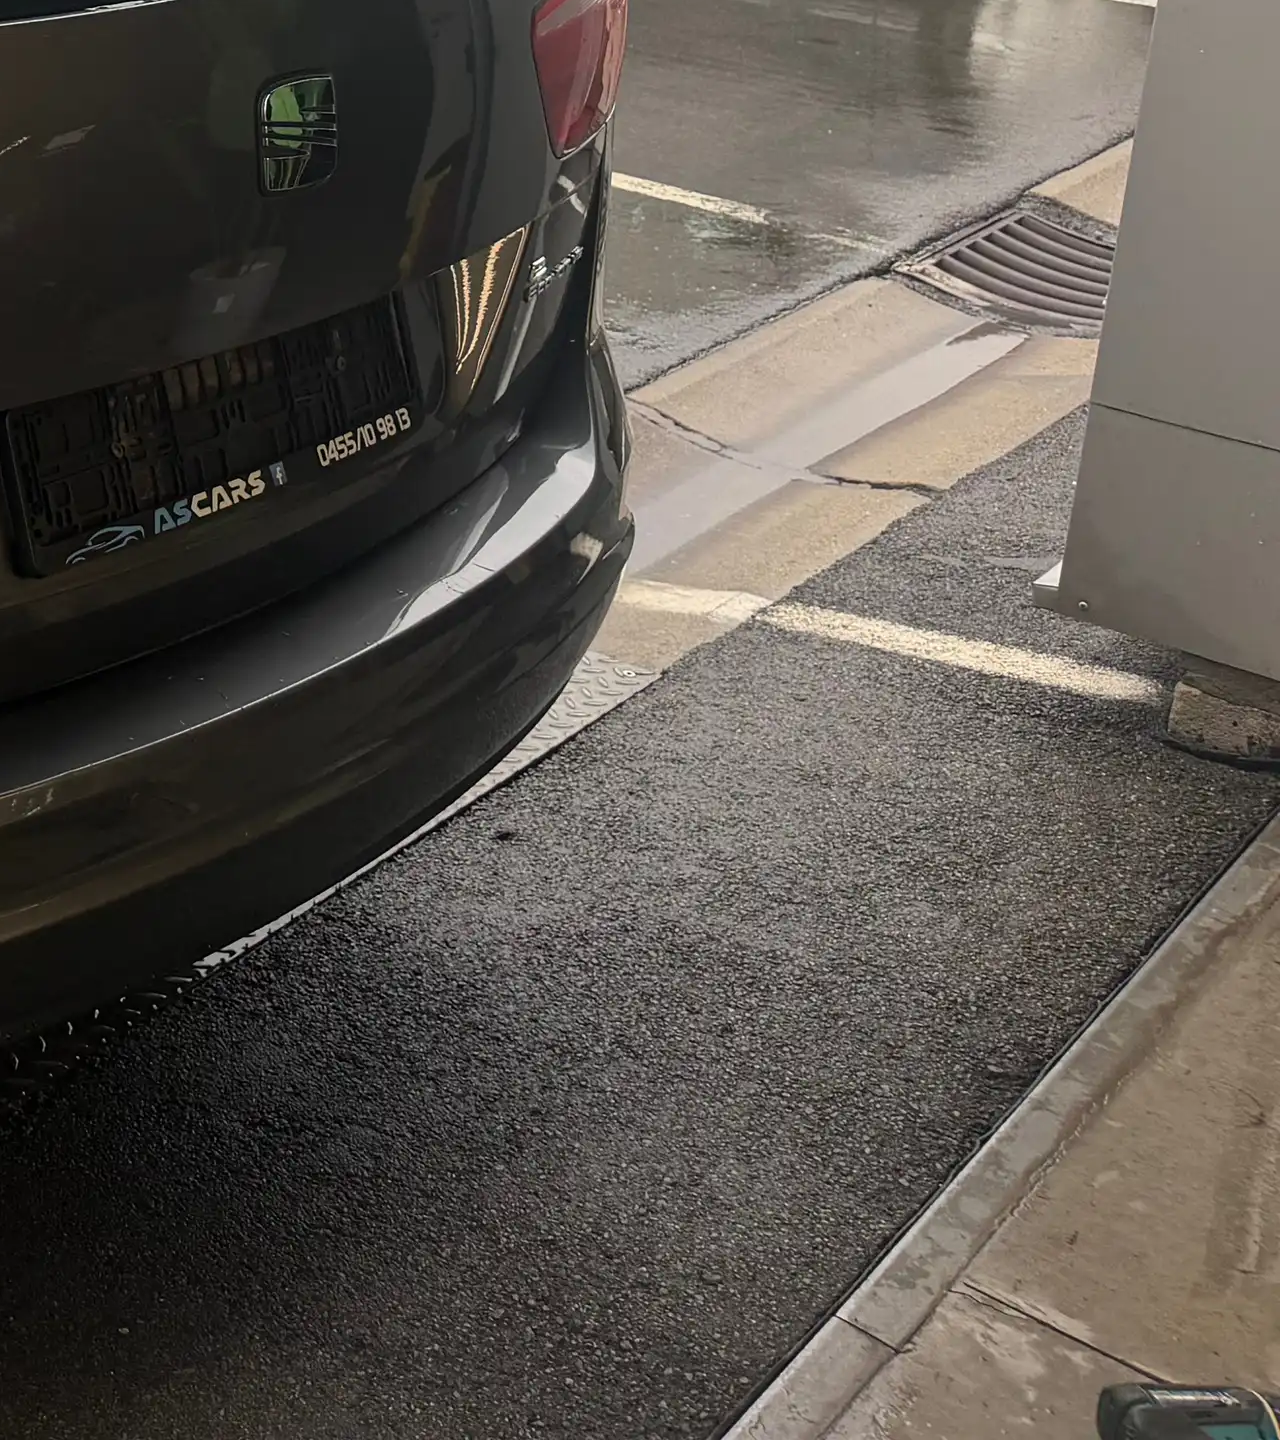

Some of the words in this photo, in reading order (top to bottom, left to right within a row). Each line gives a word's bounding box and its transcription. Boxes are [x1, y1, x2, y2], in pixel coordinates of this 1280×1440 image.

[316, 423, 377, 467] 0455/10
[375, 414, 397, 441] 98
[396, 407, 412, 433] 13
[154, 469, 266, 535] ASCARS
